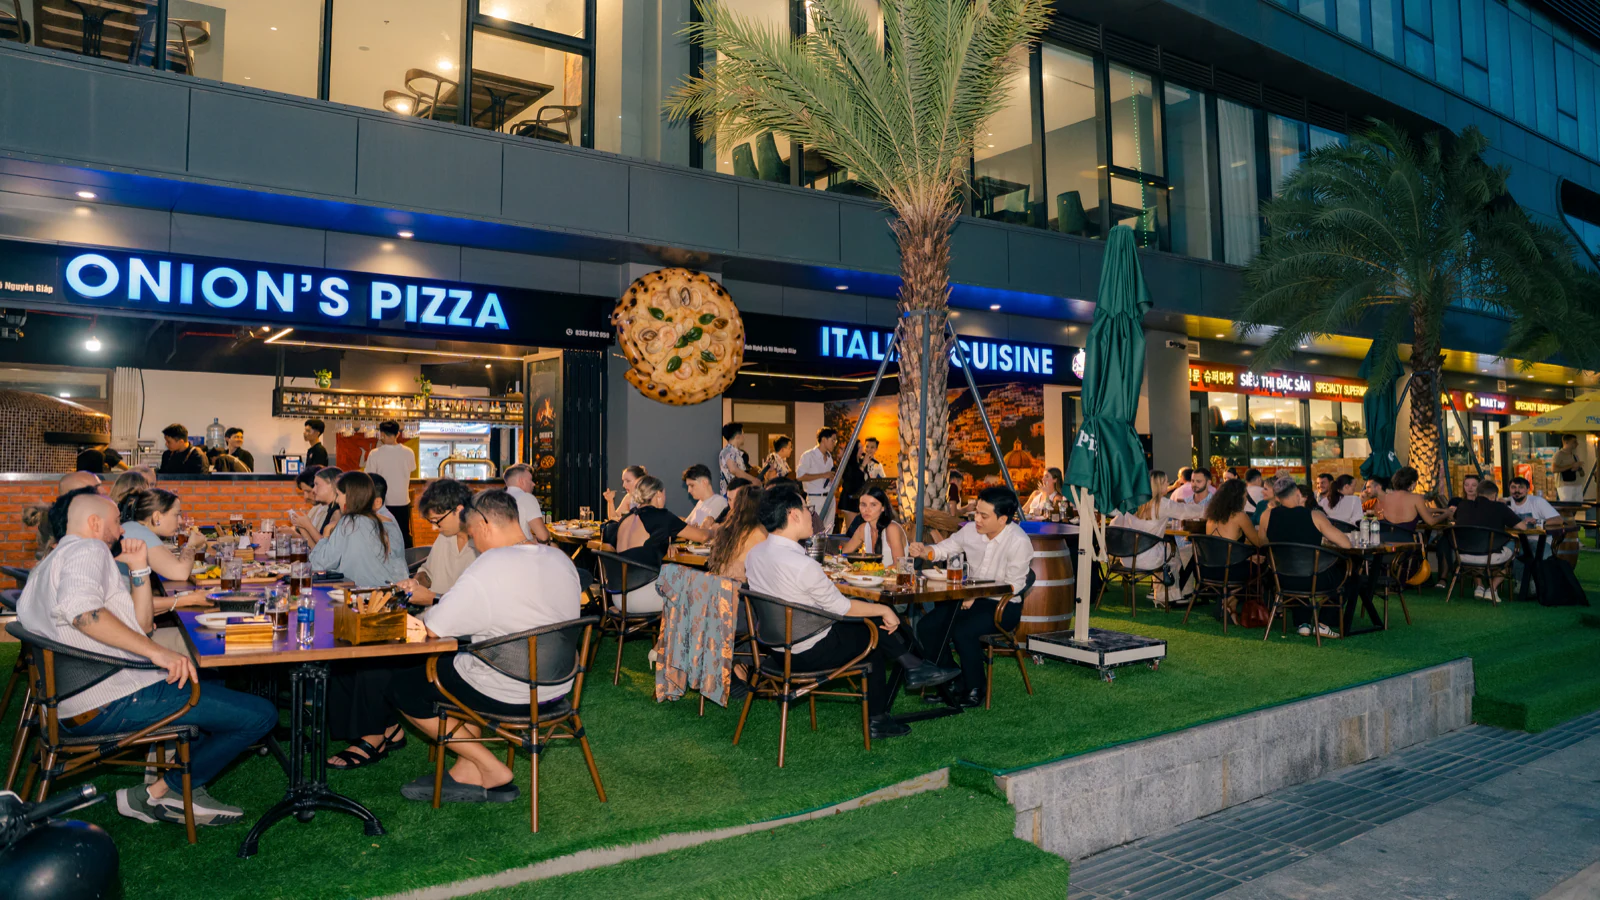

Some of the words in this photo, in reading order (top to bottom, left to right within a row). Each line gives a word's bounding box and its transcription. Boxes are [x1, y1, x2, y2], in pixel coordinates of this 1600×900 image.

[66, 253, 350, 317] ONION'S
[371, 281, 510, 330] PIZZA
[820, 326, 902, 363] ITALI
[949, 340, 1053, 375] CUISINE
[1203, 369, 1234, 386] 슈퍼마켓
[1315, 381, 1343, 395] SPECIALTY
